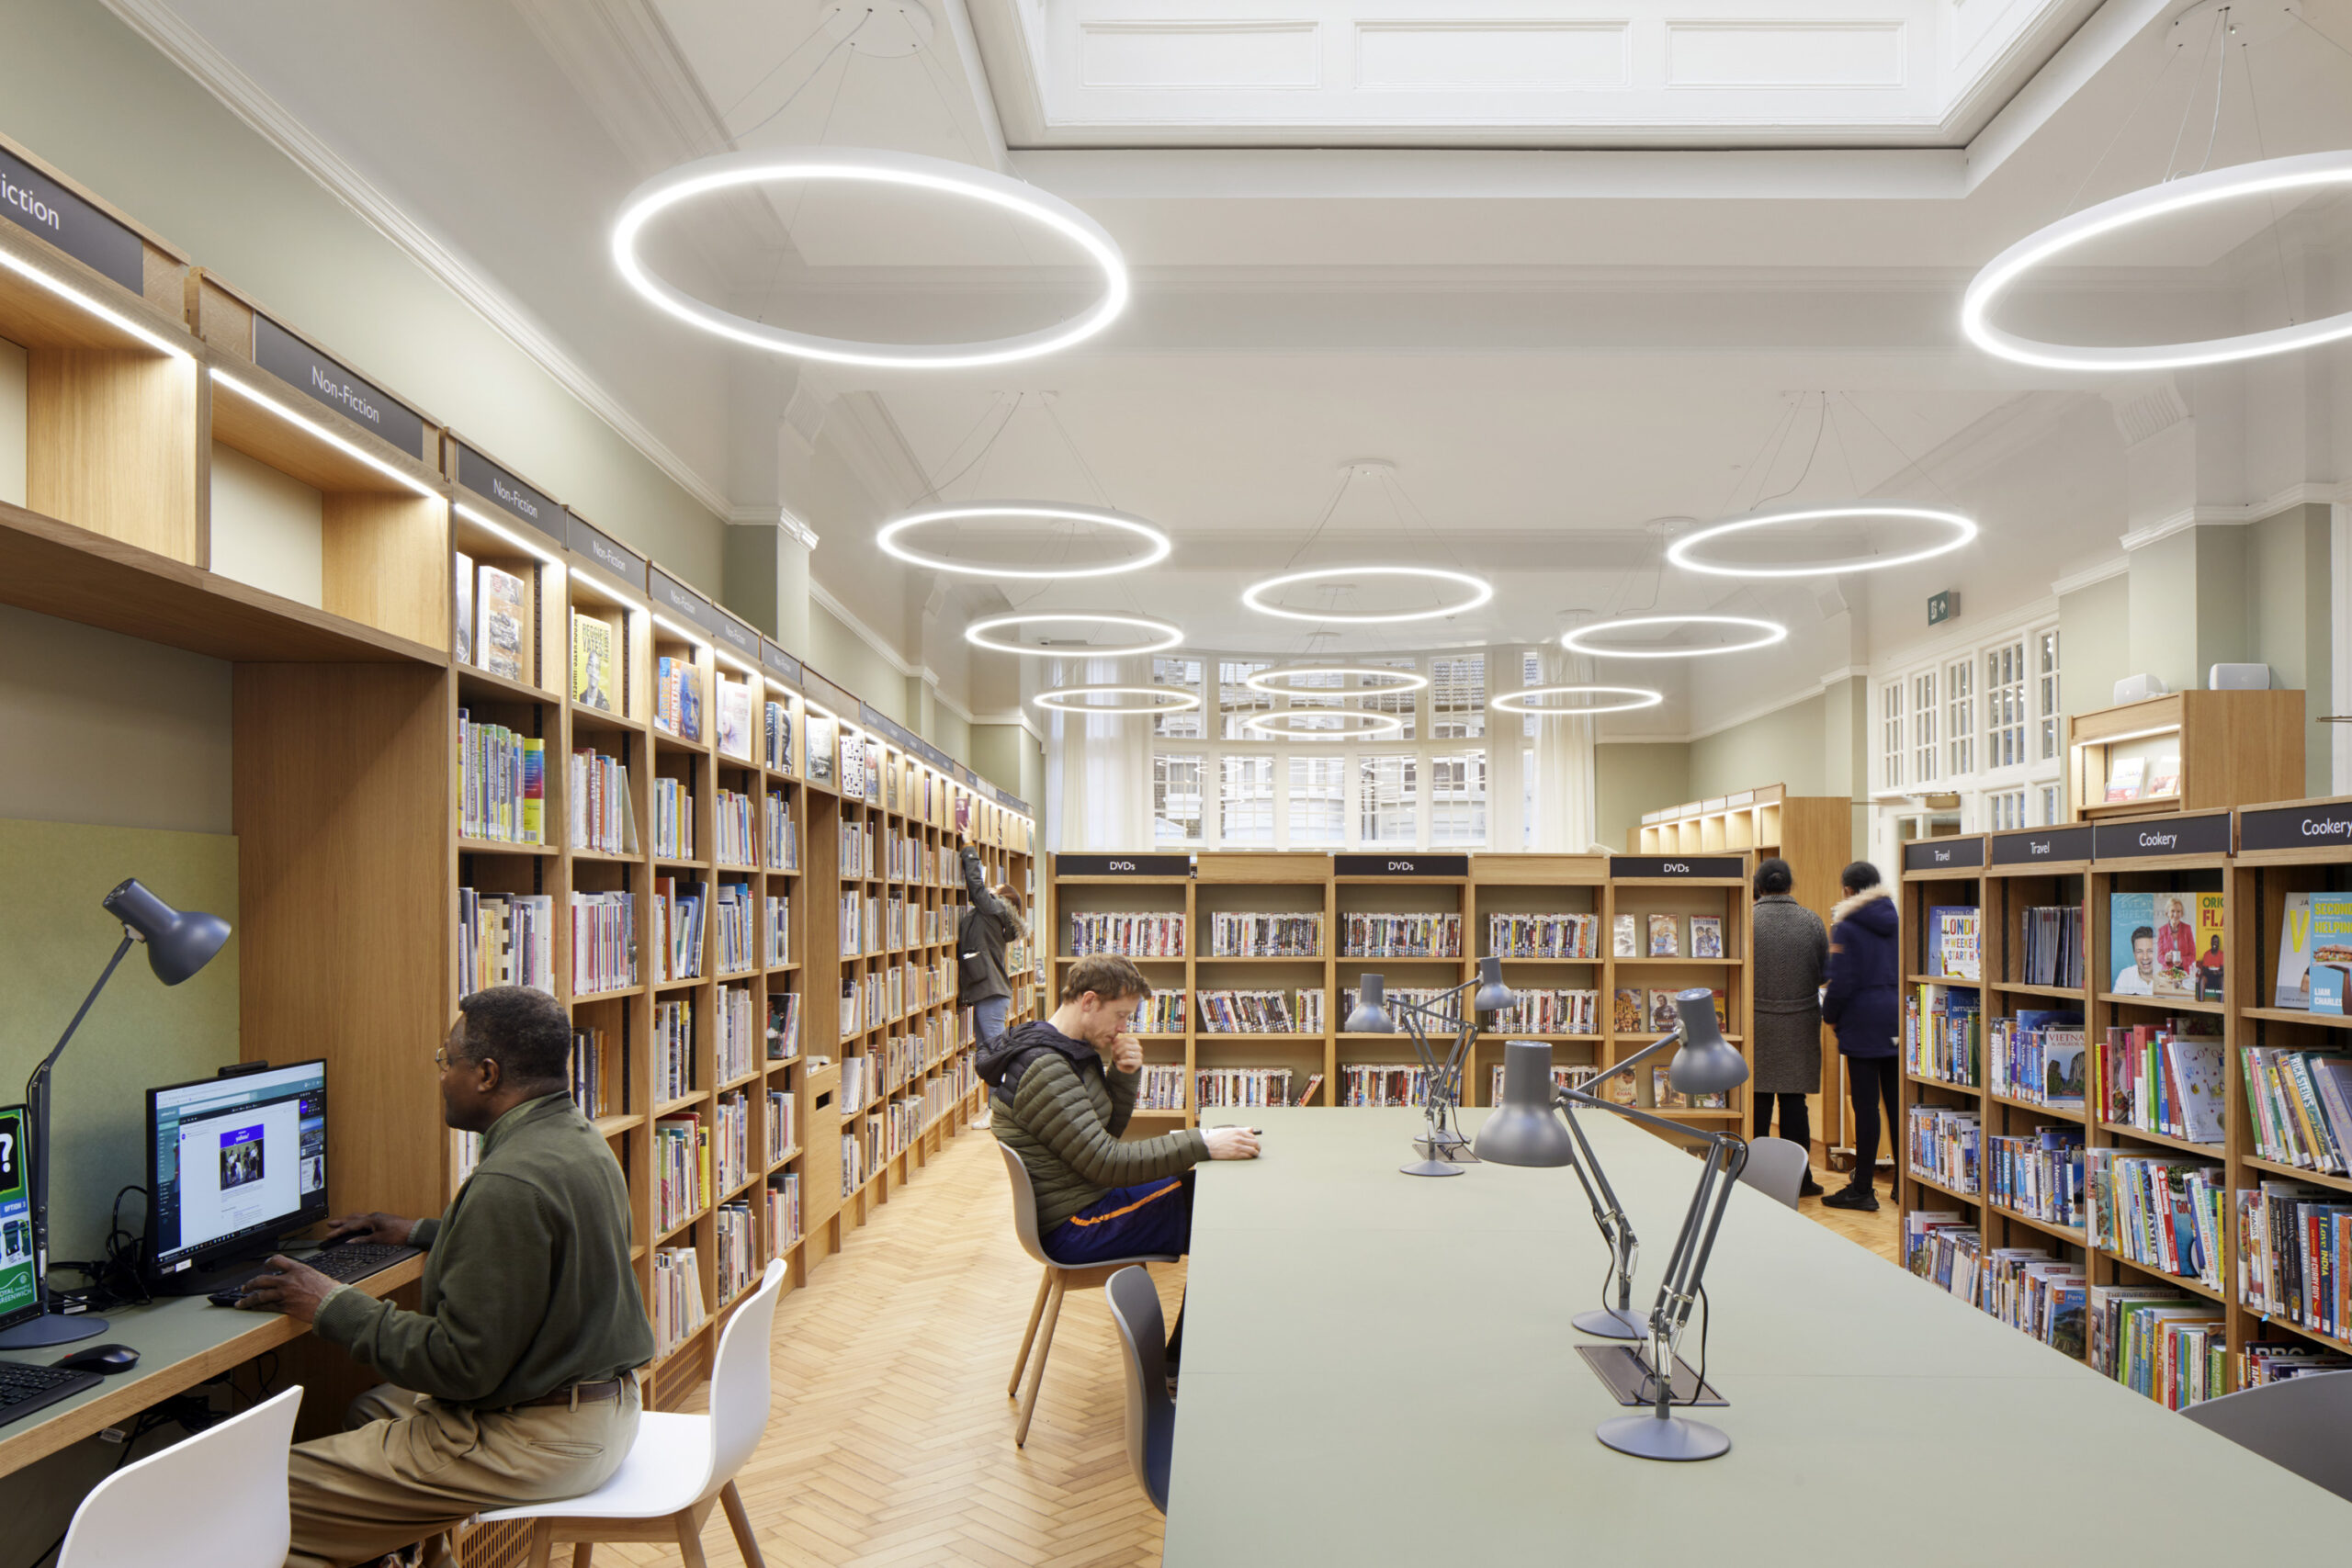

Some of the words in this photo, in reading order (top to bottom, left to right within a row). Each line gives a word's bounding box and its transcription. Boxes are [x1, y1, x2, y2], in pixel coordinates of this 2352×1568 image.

[312, 366, 379, 423] Non-Fiction
[493, 479, 537, 519] Non-Fiction
[593, 540, 627, 573] Non-Fiction
[582, 623, 603, 638] REGGIE
[582, 637, 603, 657] YATES
[2301, 818, 2352, 838] Cookery
[2030, 840, 2051, 855] Travel
[2139, 831, 2177, 849] Cookery
[1935, 850, 1951, 862] Travel
[1110, 861, 1136, 871] DVDs
[1388, 862, 1414, 871] DVDs
[1664, 863, 1690, 873] DVDs
[1950, 938, 1974, 948] WEEKE
[2314, 987, 2331, 996] LIAM
[2290, 1057, 2302, 1078] RICK
[2297, 1078, 2313, 1108] STEIN'S
[4, 1202, 21, 1213] OPTION
[2320, 1223, 2328, 1248] Love
[2205, 1254, 2214, 1271] START
[2321, 1249, 2329, 1277] INDIA
[2311, 1263, 2320, 1284] CURRY
